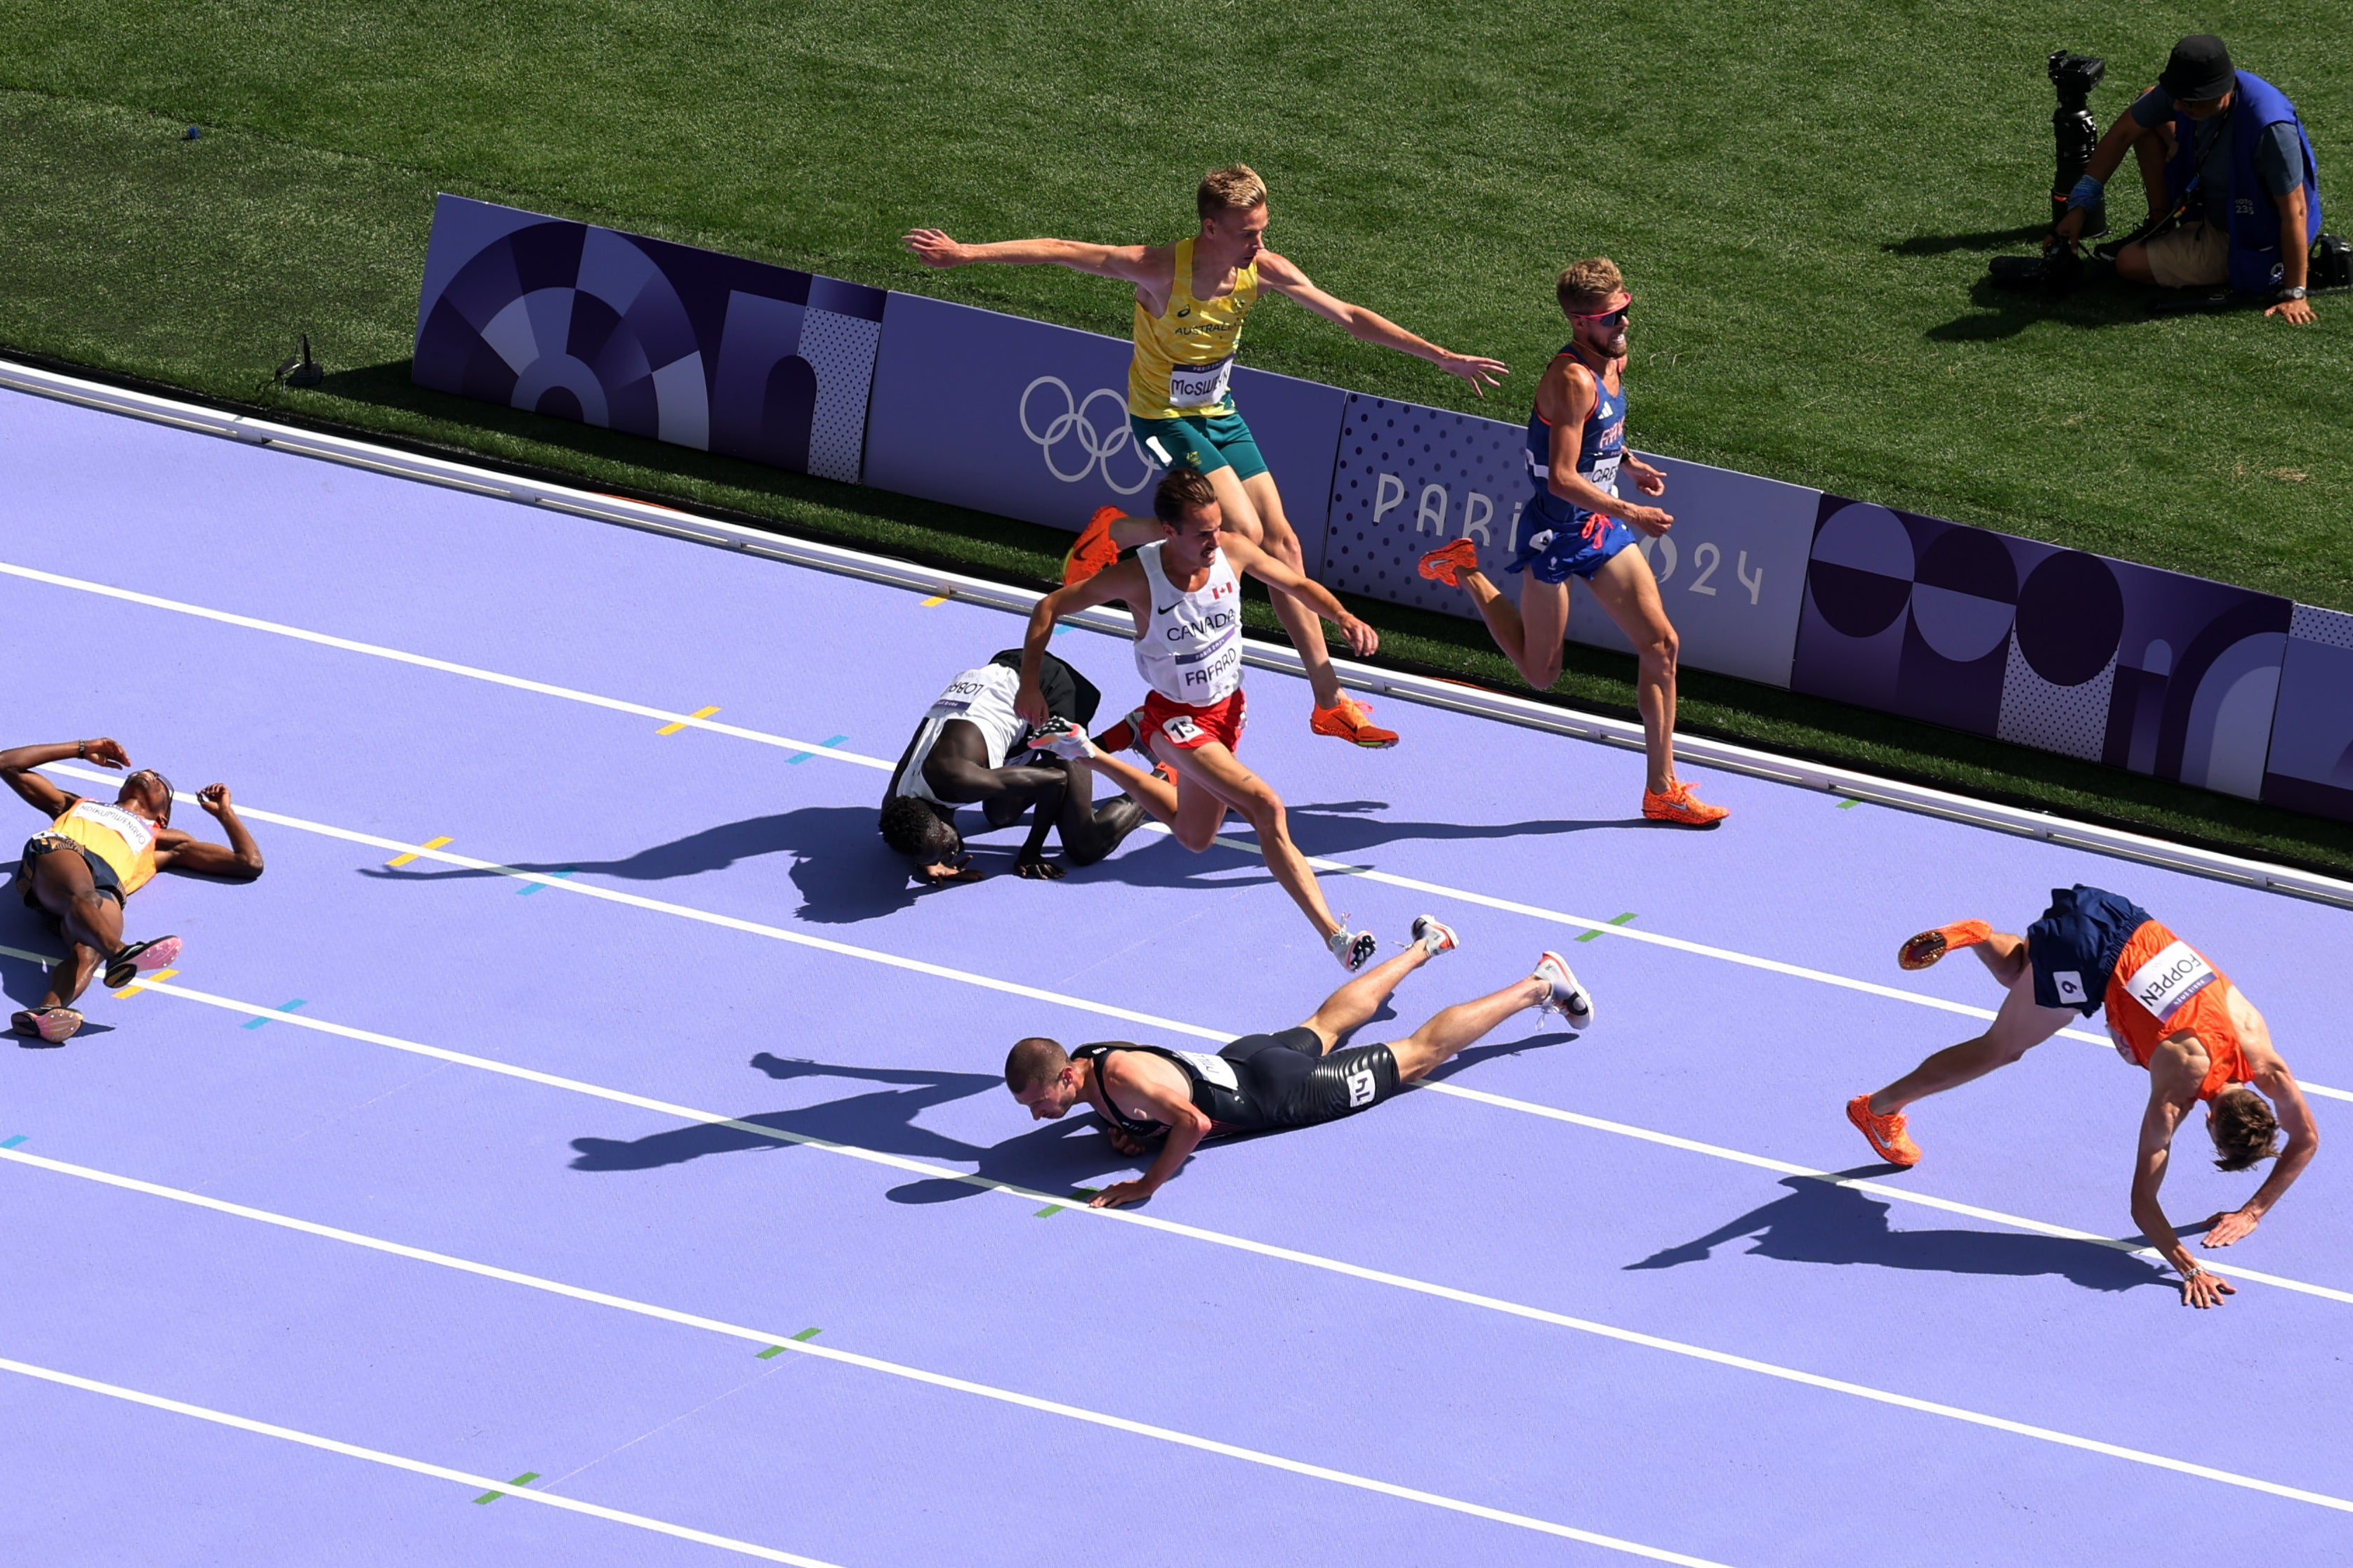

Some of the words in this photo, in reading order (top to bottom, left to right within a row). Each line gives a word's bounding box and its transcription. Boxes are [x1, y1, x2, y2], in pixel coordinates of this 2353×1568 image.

[1166, 608, 1235, 641] CANADA
[1185, 647, 1237, 686] FAFARD
[1171, 720, 1195, 739] 15
[79, 805, 146, 845] NDIKUMWENAYO
[2140, 954, 2202, 1007] FOPPEN
[1355, 1077, 1370, 1102] 14
